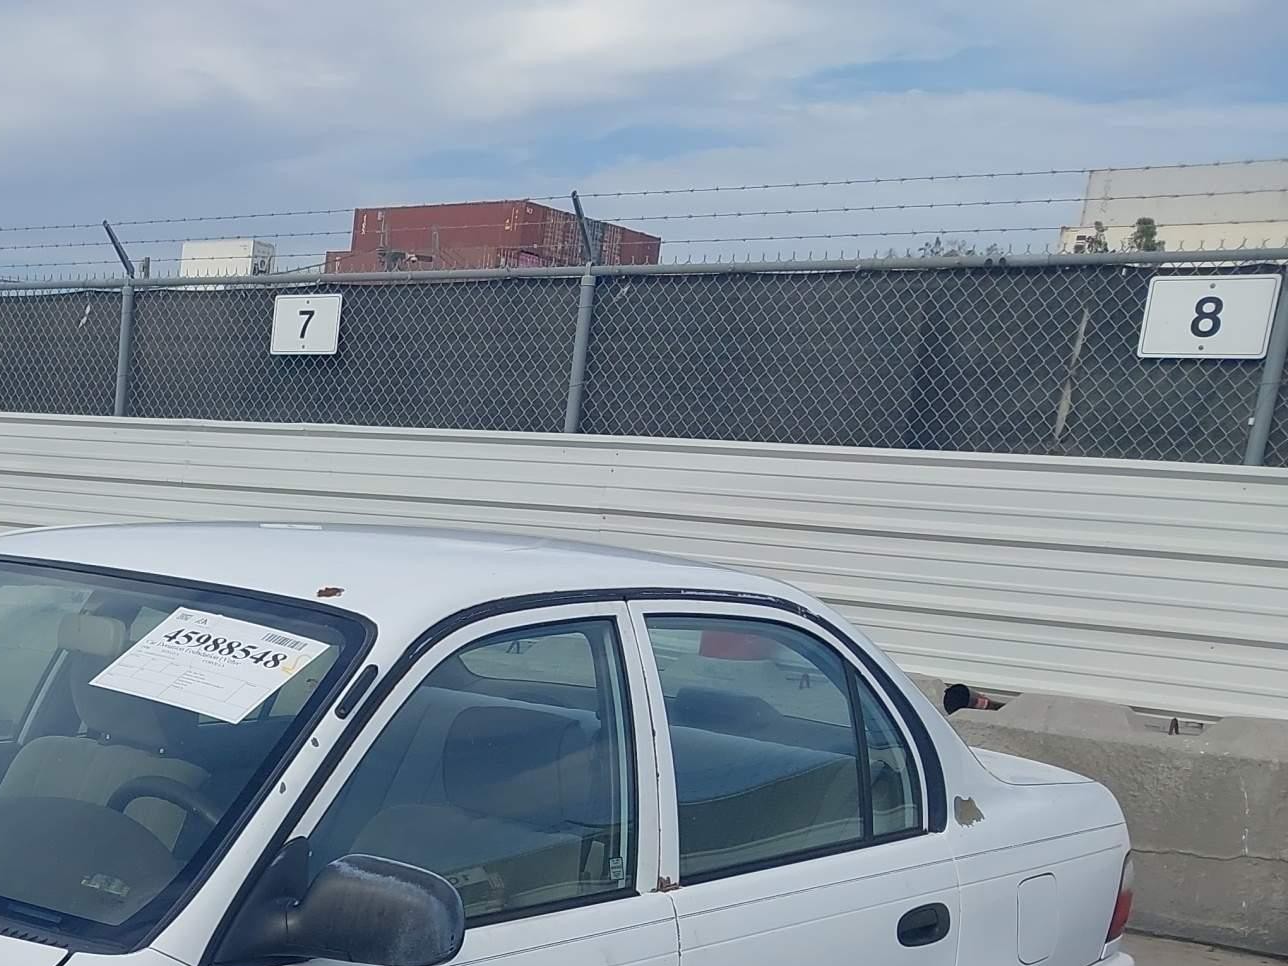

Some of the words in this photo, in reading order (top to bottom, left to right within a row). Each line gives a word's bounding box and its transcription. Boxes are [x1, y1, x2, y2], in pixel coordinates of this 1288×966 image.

[299, 310, 315, 339] 7
[1190, 296, 1224, 338] 8
[163, 628, 288, 670] 45988548
